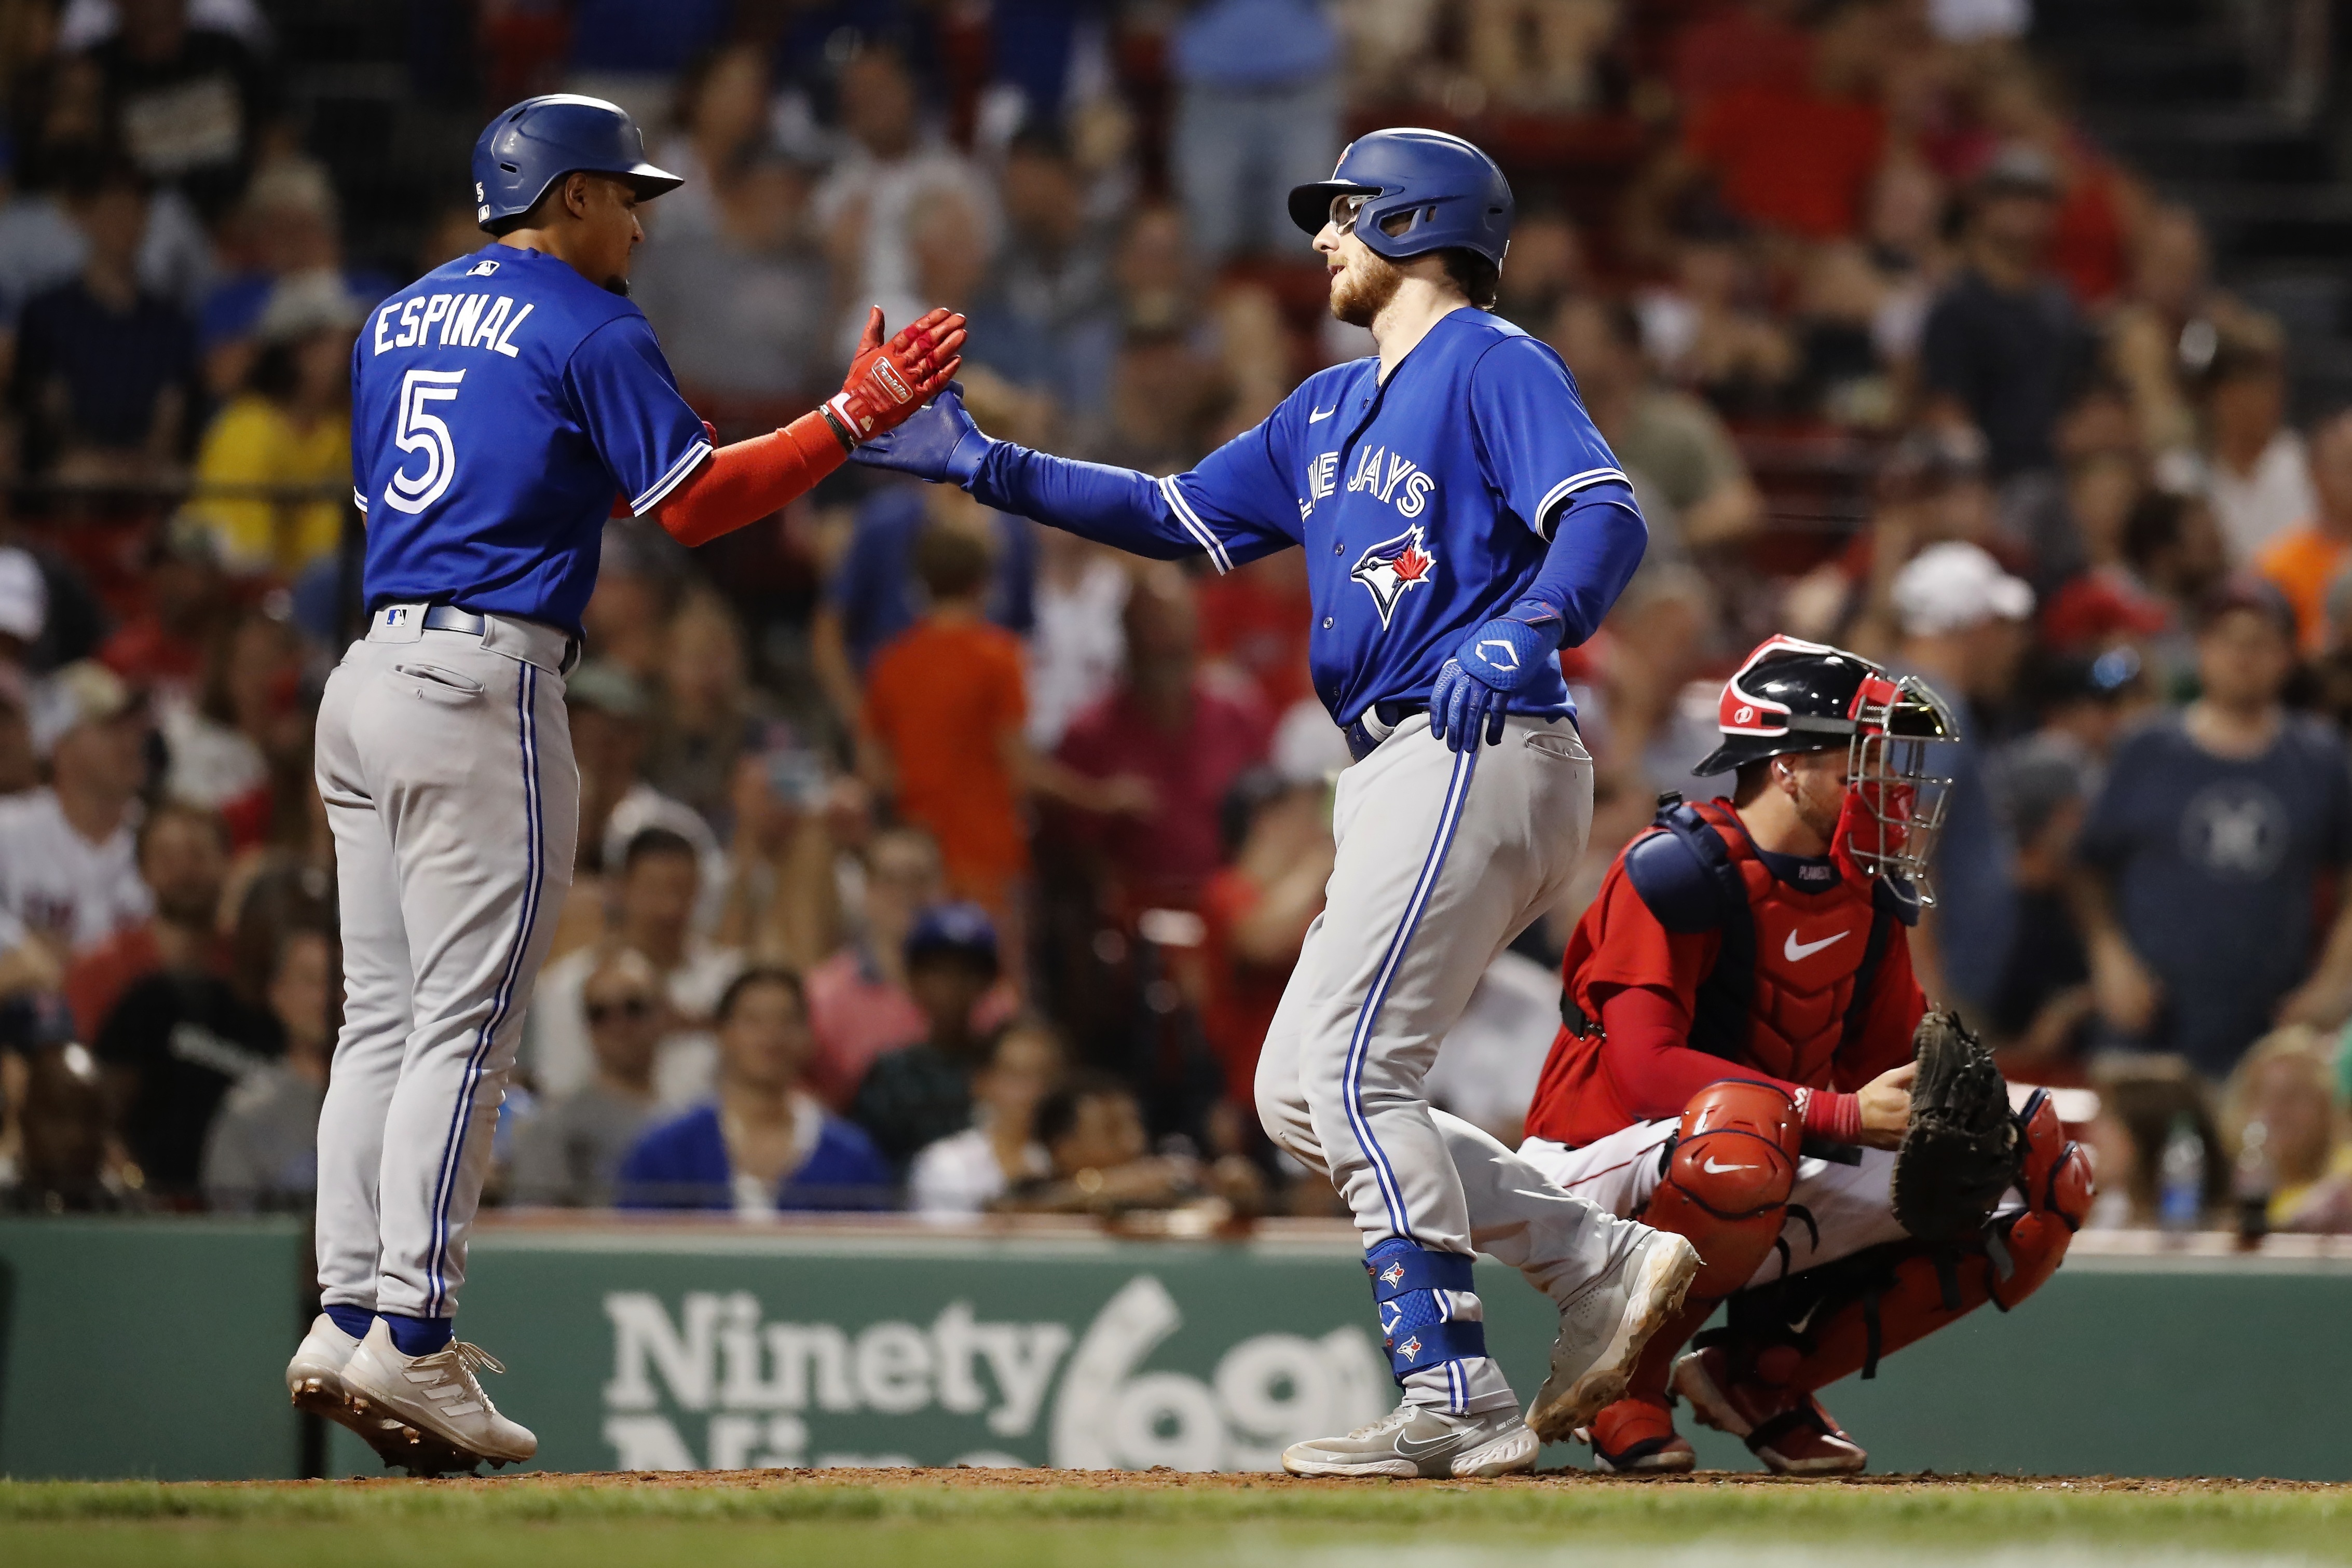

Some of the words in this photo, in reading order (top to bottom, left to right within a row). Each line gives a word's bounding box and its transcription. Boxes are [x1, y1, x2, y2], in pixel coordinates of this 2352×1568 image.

[476, 182, 484, 202] 5
[375, 294, 535, 358] ESPINAL
[384, 368, 467, 514] 5
[1347, 445, 1435, 518] JAYS
[602, 1291, 1070, 1436] Ninety
